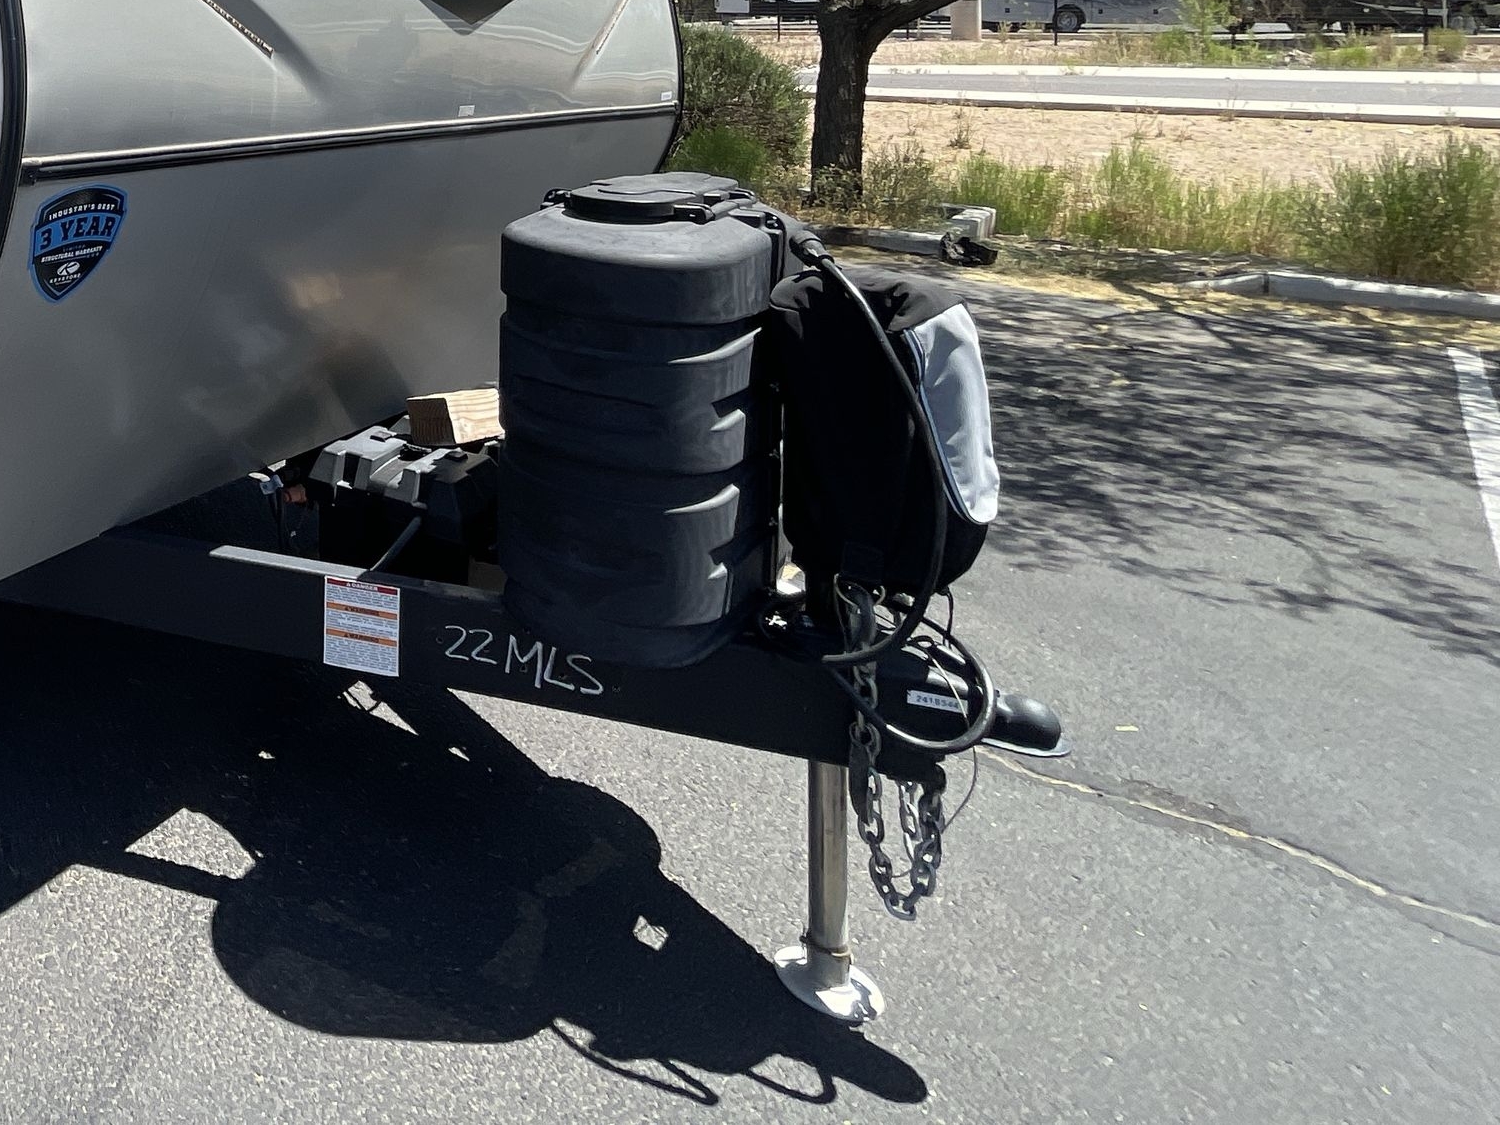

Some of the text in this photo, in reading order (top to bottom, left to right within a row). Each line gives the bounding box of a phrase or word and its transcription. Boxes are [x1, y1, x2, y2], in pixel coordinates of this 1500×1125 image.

[48, 203, 115, 221] INDUSTRY'S BEST
[40, 215, 116, 250] 3 YEAR
